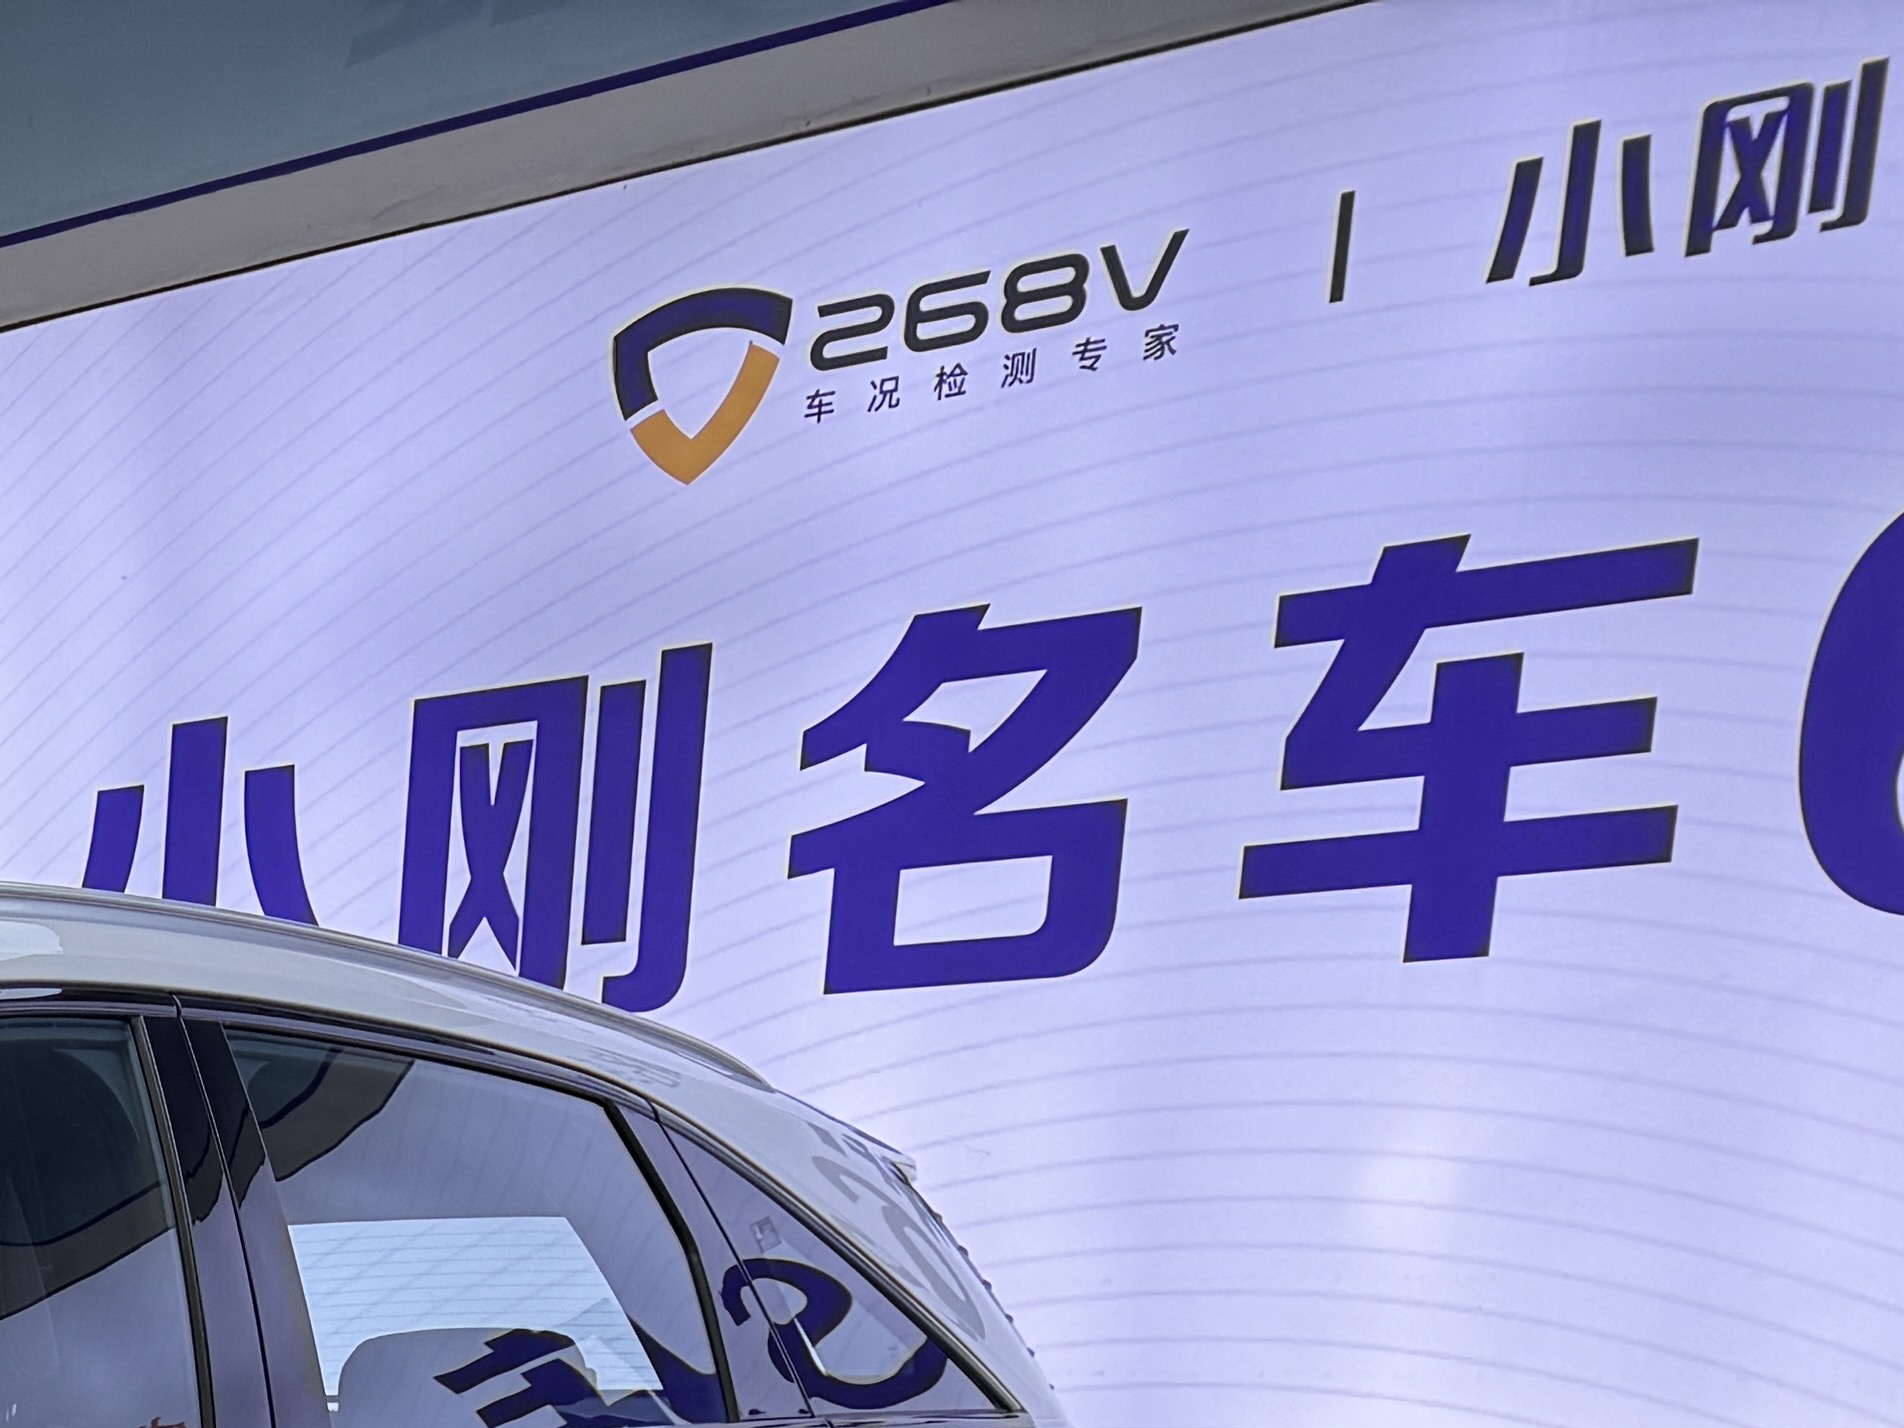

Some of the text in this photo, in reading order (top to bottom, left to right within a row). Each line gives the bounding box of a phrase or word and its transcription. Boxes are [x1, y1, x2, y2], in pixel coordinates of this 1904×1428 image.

[1485, 57, 1890, 288] 小刚
[809, 228, 1190, 371] 268V
[803, 322, 1181, 424] 车况检测专家
